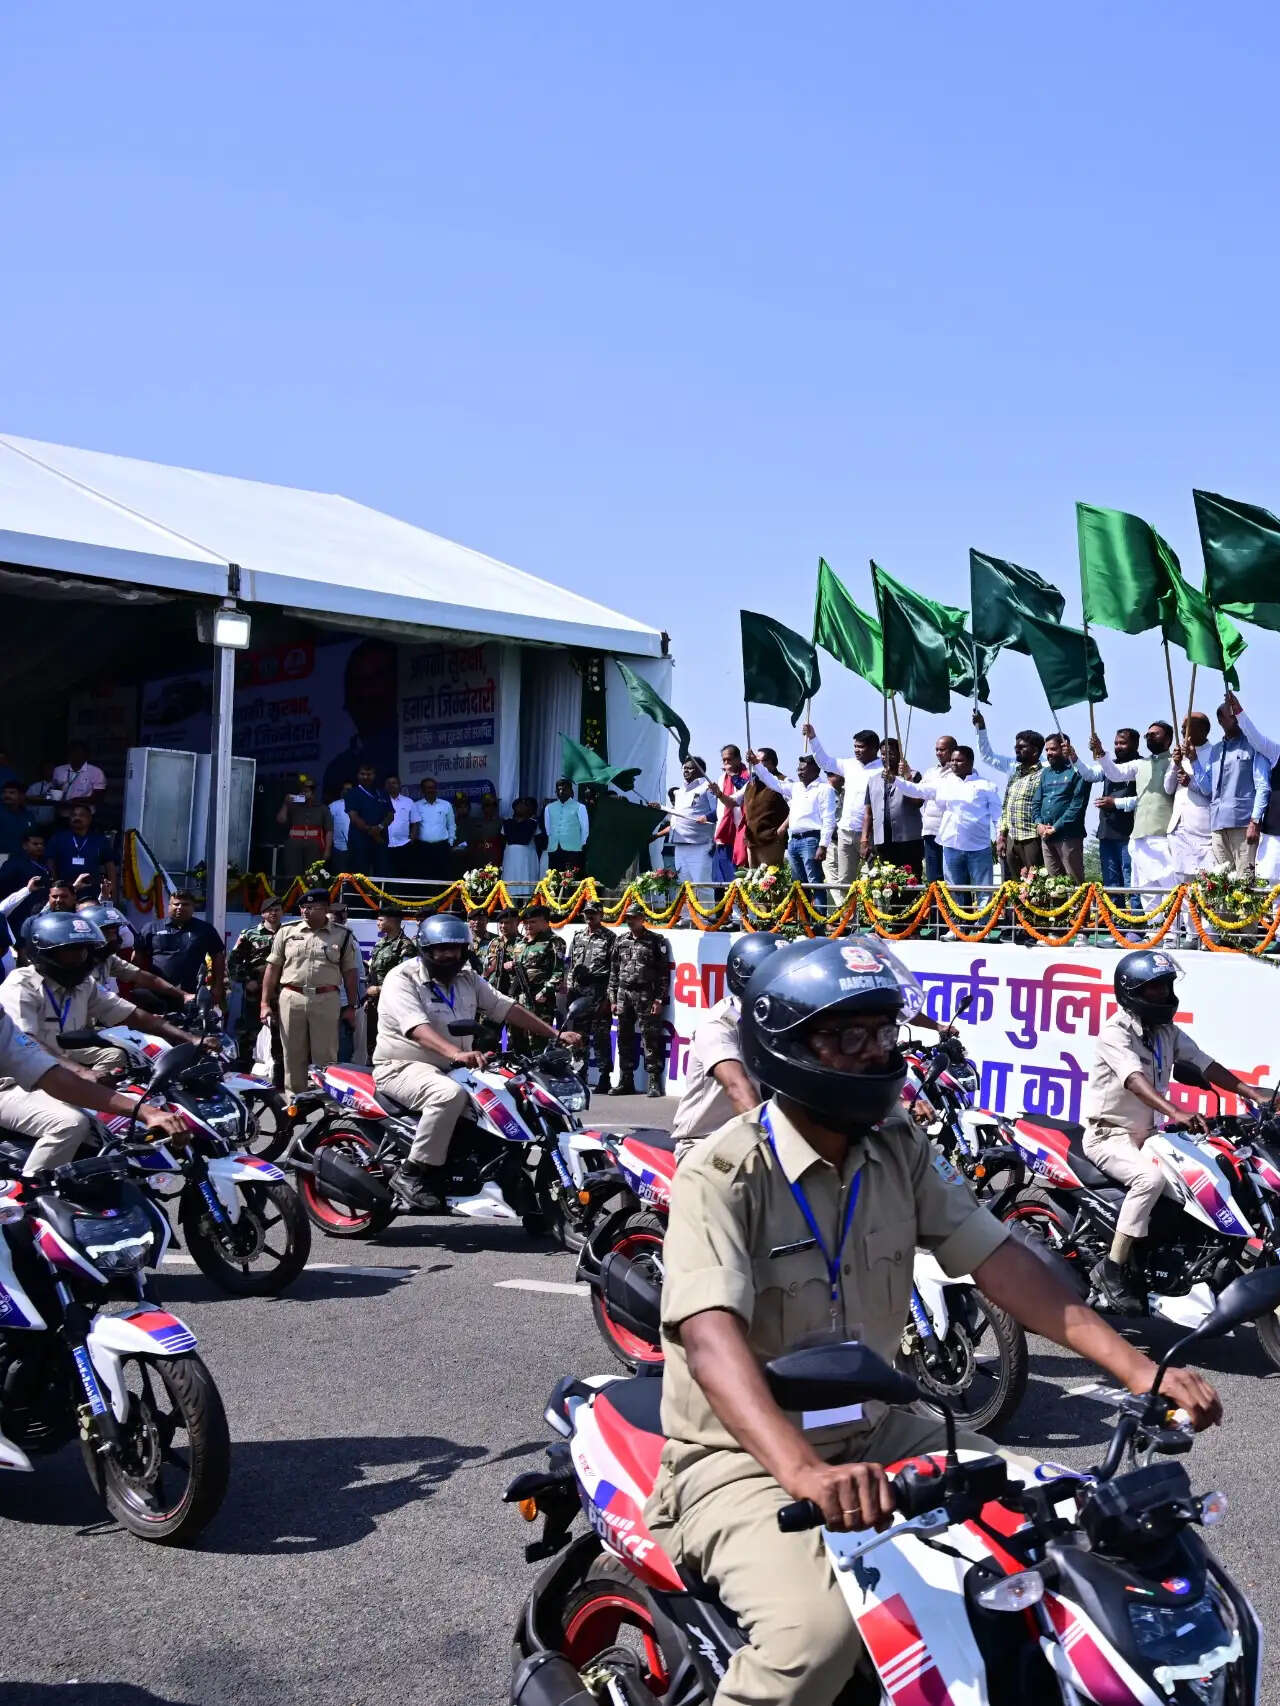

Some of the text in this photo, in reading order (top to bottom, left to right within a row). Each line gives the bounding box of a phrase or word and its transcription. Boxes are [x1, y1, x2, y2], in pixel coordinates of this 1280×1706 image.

[1033, 1160, 1069, 1183] POLICE
[1082, 1196, 1116, 1223] Apache
[1218, 1210, 1233, 1226] 112
[1155, 1270, 1169, 1278] TVS
[588, 1502, 656, 1567] POLICE
[686, 1623, 726, 1679] Apa
